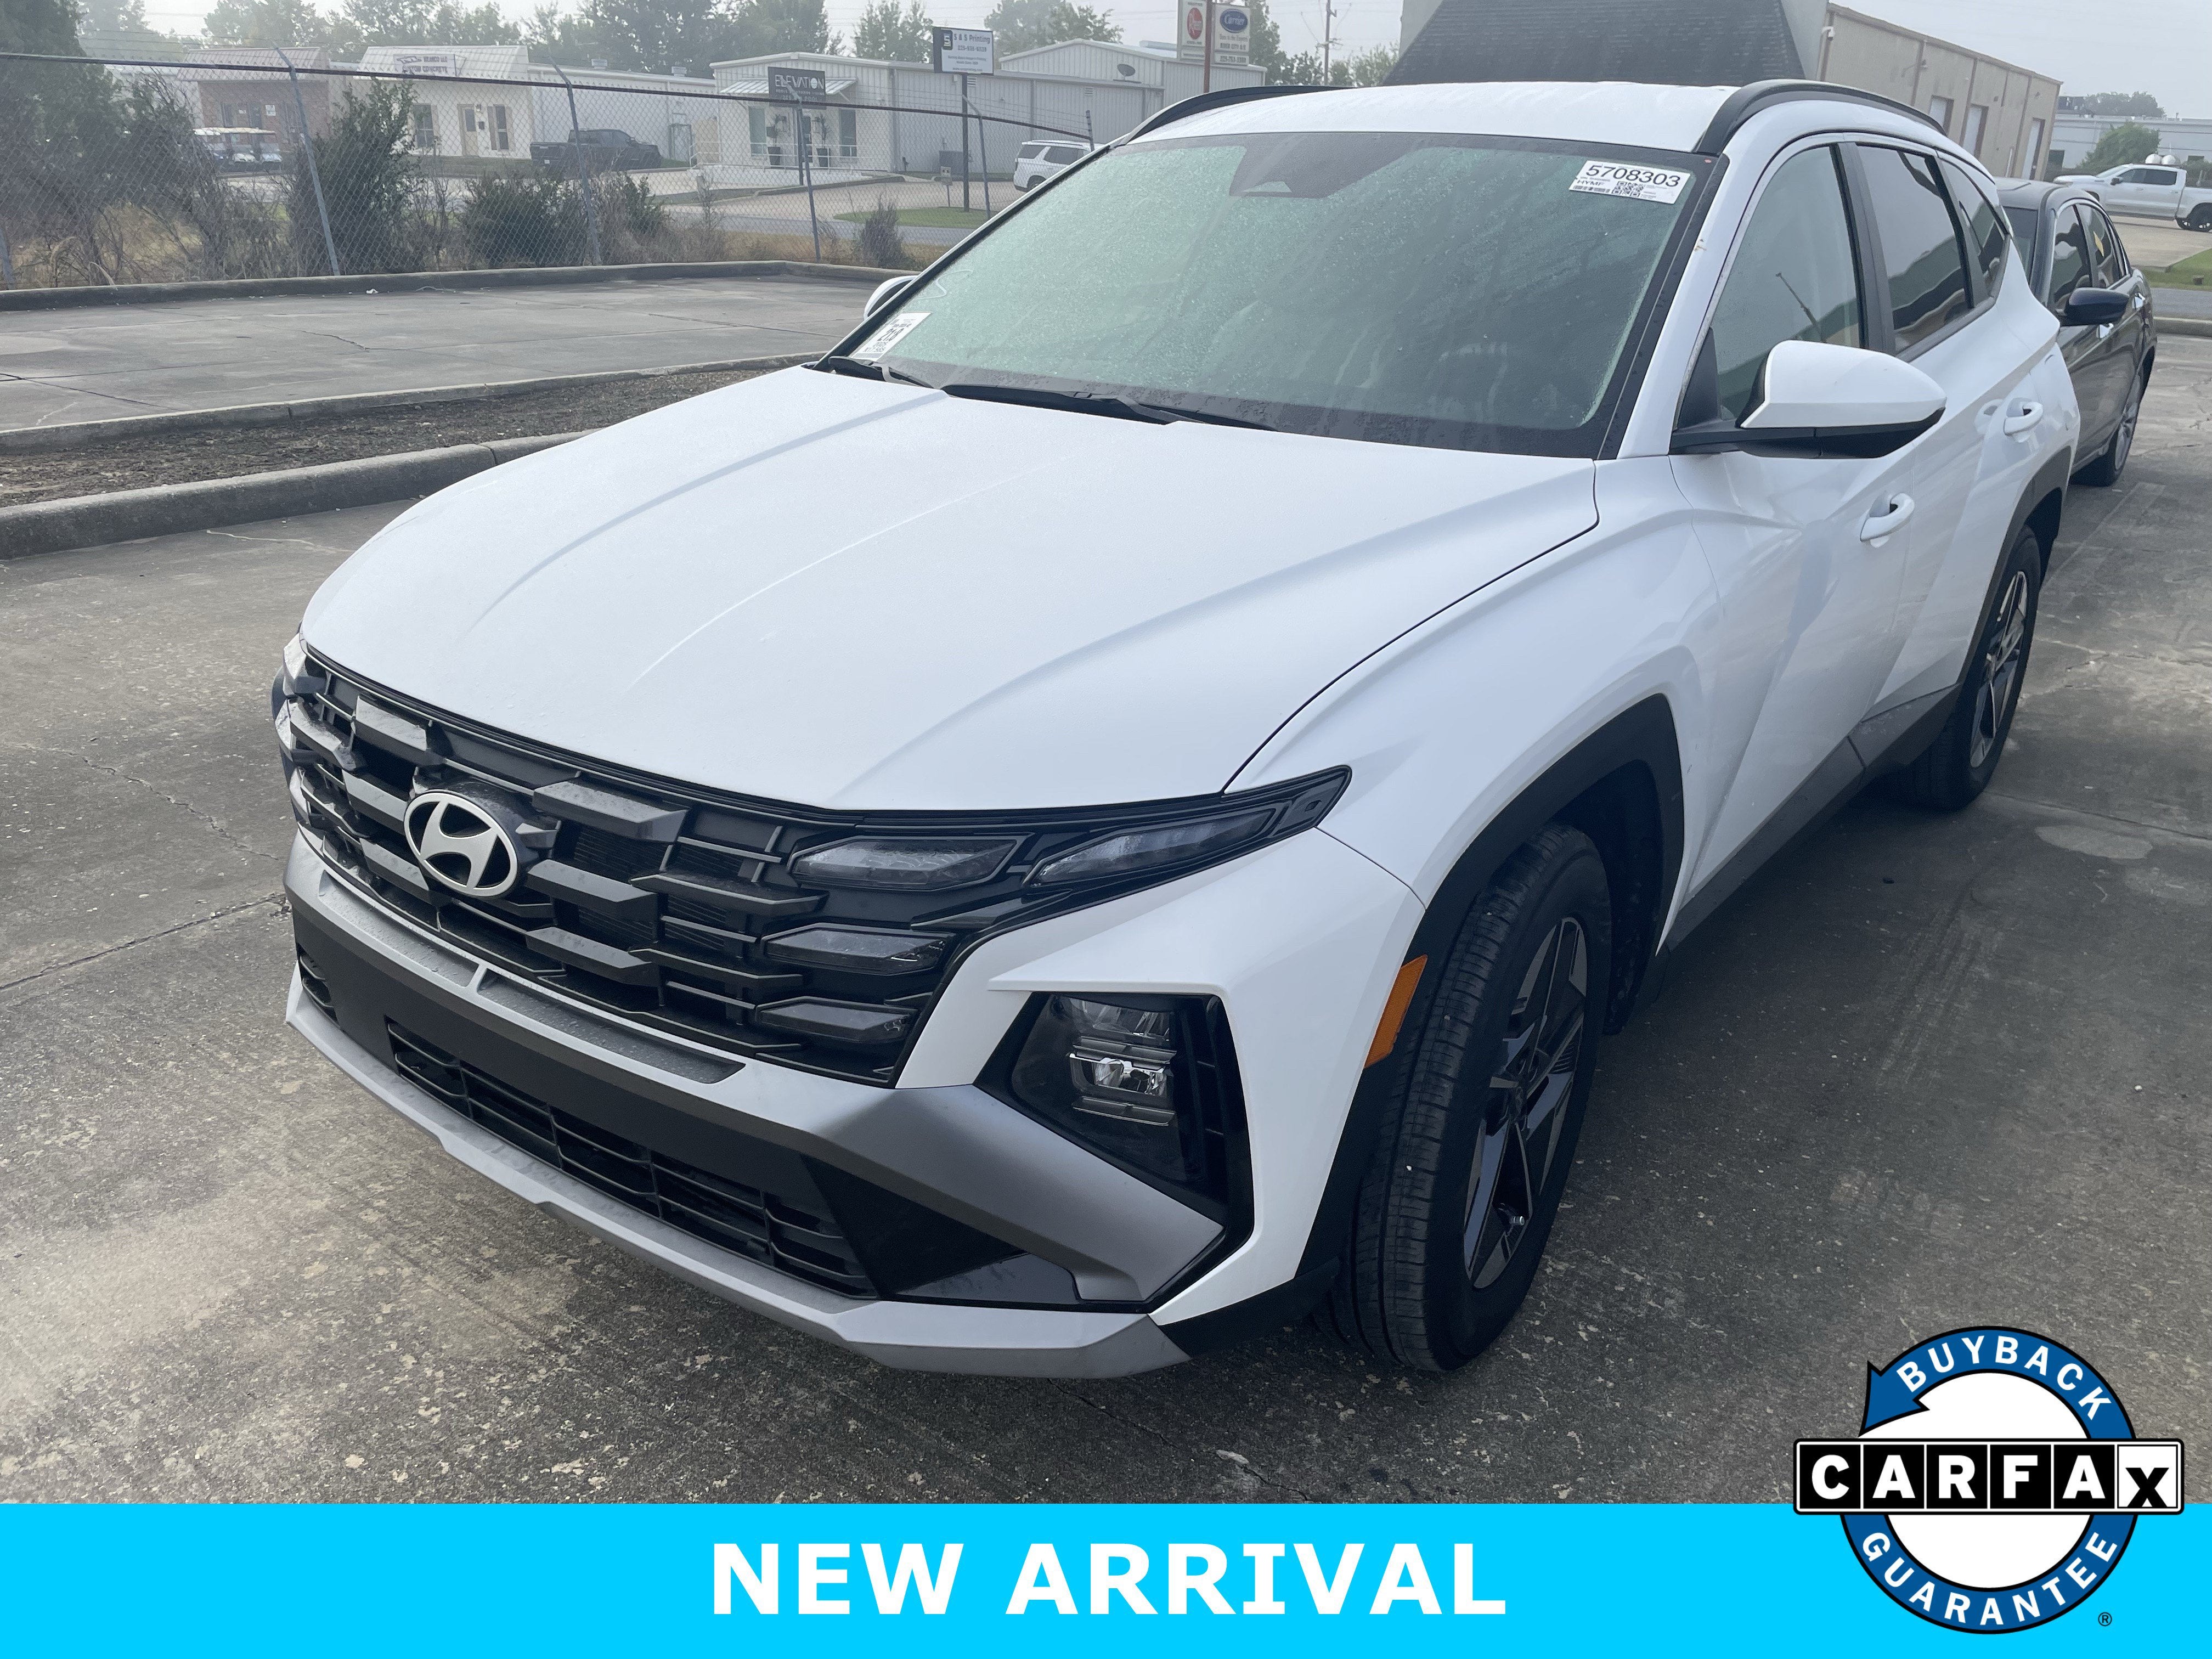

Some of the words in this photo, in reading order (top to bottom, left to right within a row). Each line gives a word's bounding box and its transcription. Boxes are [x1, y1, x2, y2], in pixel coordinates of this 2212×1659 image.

[1224, 14, 1245, 25] Carrier
[969, 35, 990, 44] Printing
[775, 75, 825, 89] ELEVATION
[1586, 165, 1681, 187] 5708303
